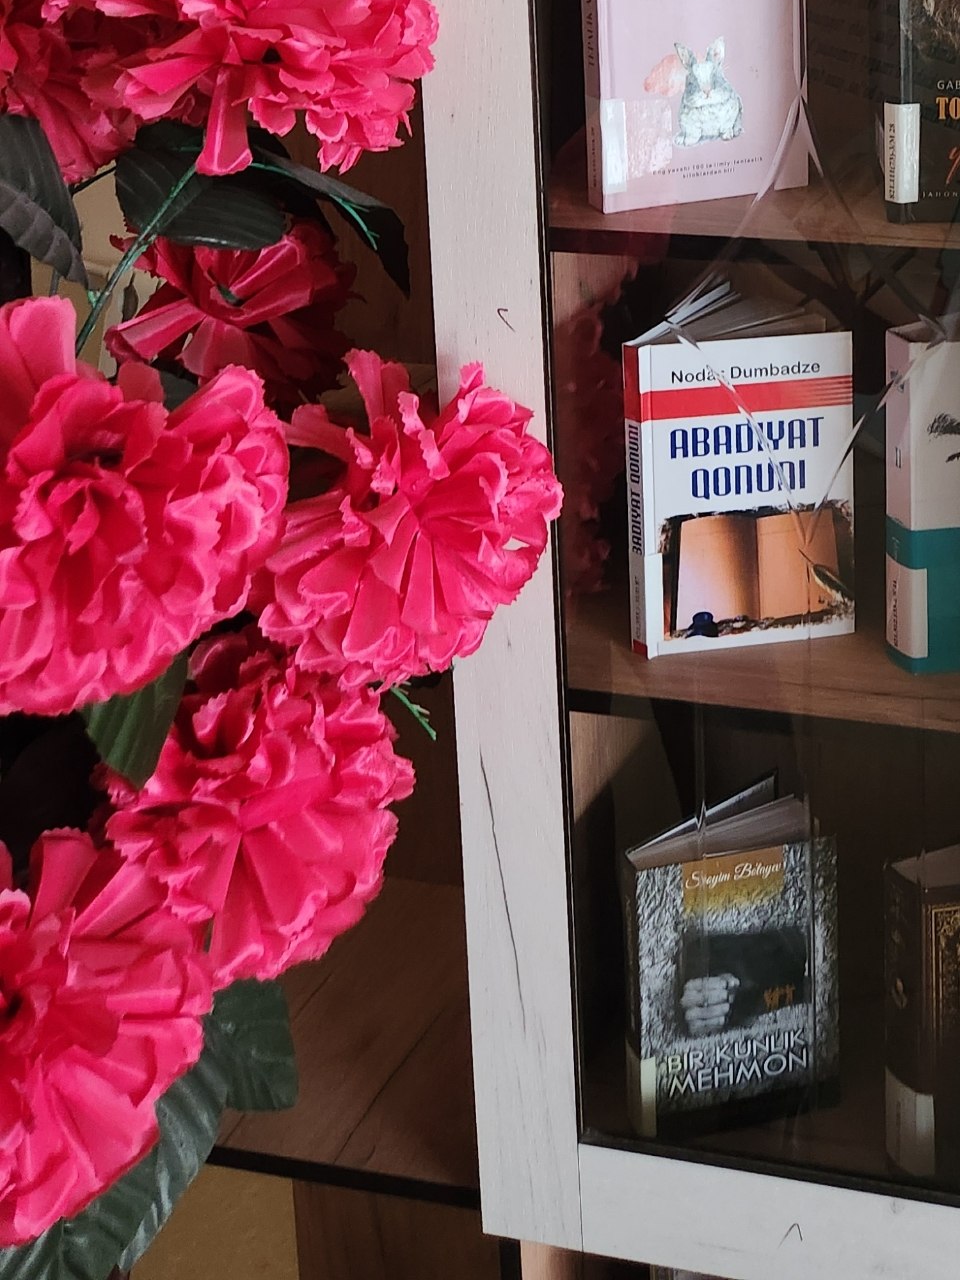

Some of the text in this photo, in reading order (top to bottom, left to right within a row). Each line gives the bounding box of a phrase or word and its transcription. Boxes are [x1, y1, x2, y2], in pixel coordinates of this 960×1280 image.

[587, 12, 595, 67] TEPALIK
[730, 361, 820, 379] Dumbadze
[670, 417, 824, 460] ABADIYAT
[628, 424, 643, 556] BADIYAT QONUNI
[691, 459, 806, 500] QONUNI
[667, 1028, 805, 1074] BIR KUNLIK
[669, 1047, 807, 1099] MEHMON
